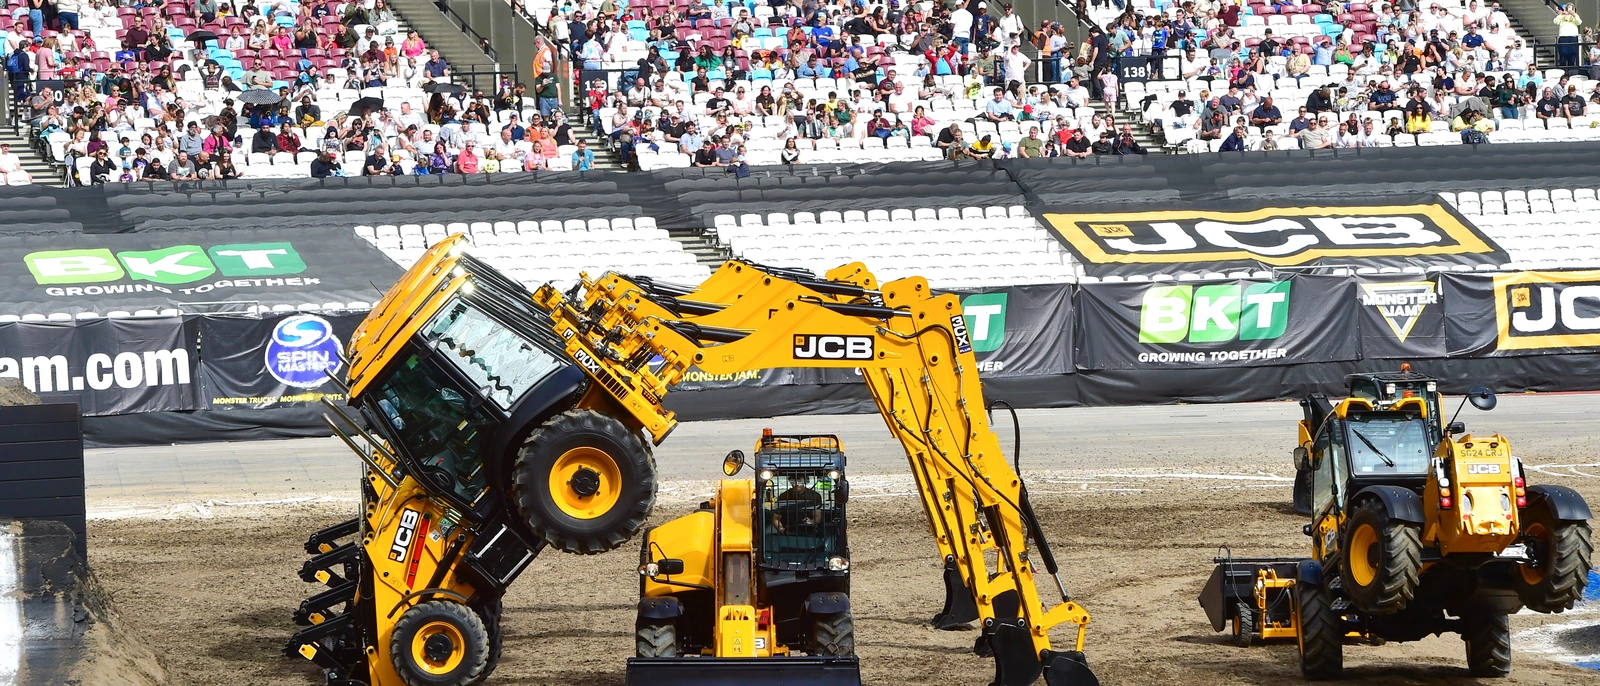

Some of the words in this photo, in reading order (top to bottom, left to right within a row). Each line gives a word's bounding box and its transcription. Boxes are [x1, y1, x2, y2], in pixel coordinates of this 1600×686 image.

[1123, 66, 1145, 78] 138
[584, 80, 607, 91] 19
[1103, 217, 1442, 255] JCB
[32, 249, 287, 277] BKT
[46, 283, 172, 296] GROWING
[178, 277, 321, 295] TOGETHER
[1362, 292, 1438, 305] MONSTER
[1144, 292, 1286, 333] BKT
[951, 316, 972, 347] 3CX
[794, 336, 873, 359] JCB
[276, 350, 330, 363] SPIN
[1138, 352, 1205, 363] GROWING
[1210, 348, 1287, 361] TOGETHER
[212, 397, 248, 405] MONSTER
[249, 396, 278, 404] TRUCKS.
[1460, 449, 1483, 457] SG24
[1485, 449, 1503, 457] CRJ
[1468, 464, 1501, 474] JCB
[392, 509, 419, 562] JCB
